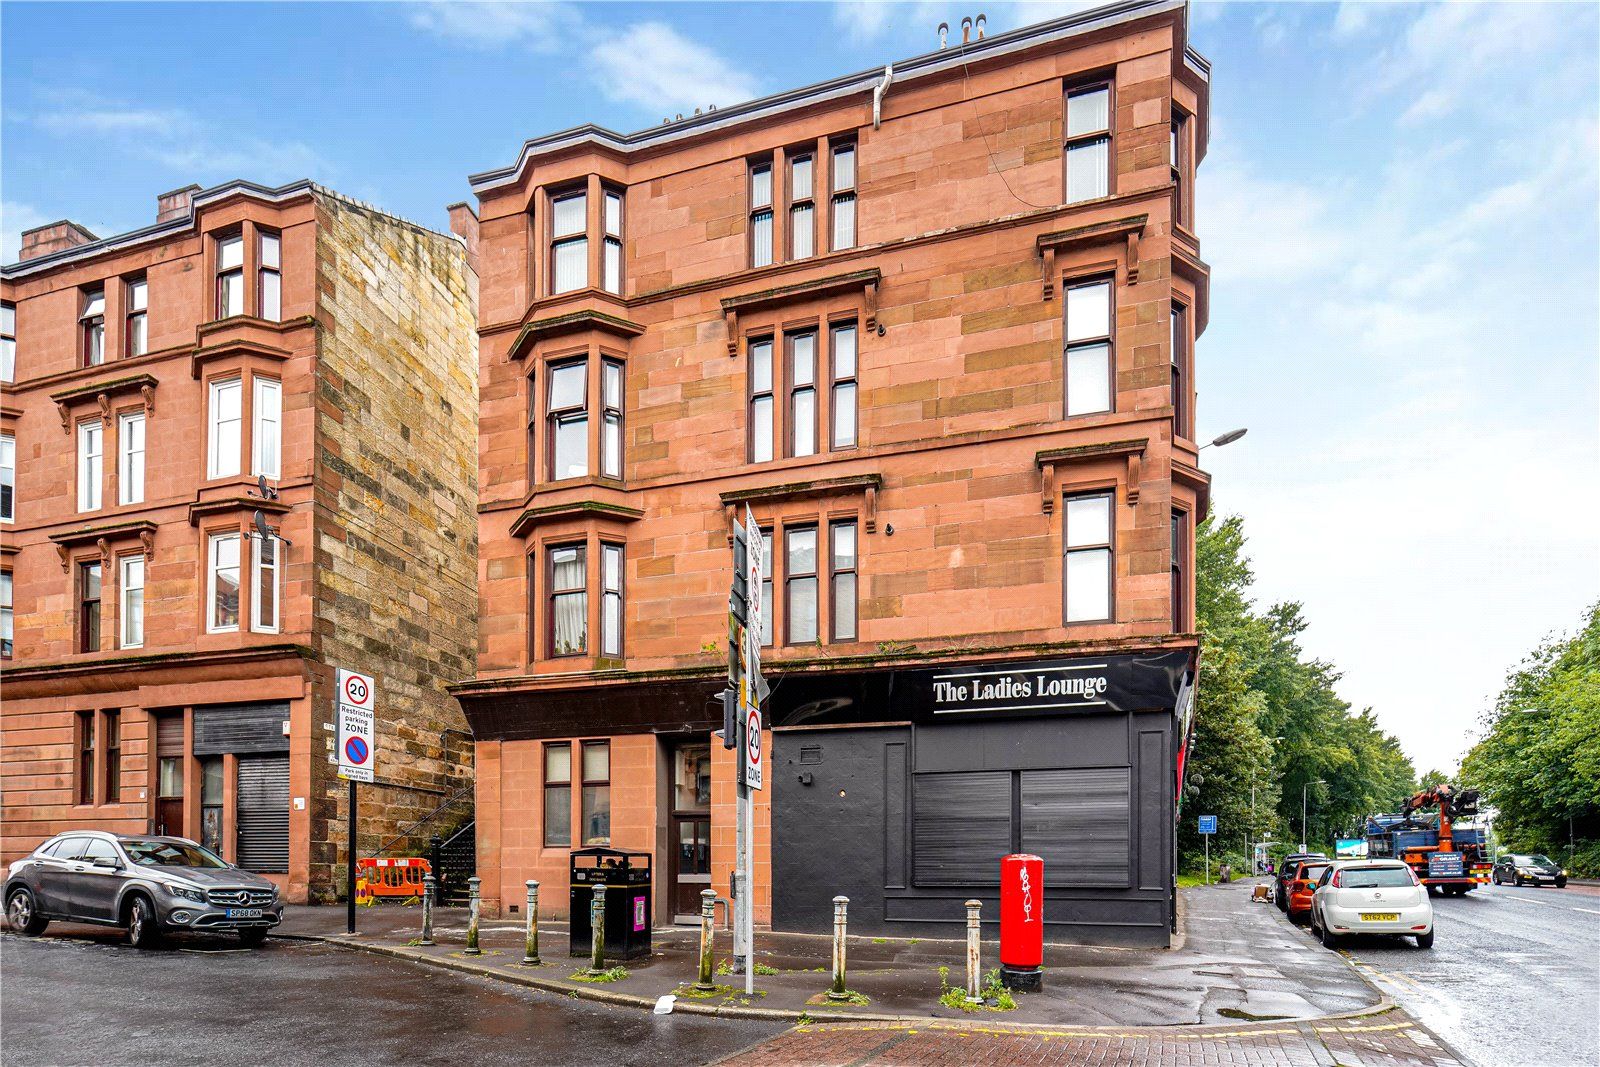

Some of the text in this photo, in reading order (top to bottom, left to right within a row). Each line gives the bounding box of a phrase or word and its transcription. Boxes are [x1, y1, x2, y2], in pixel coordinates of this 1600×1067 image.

[350, 683, 366, 697] 20
[933, 675, 1107, 703] The Ladies Lounge
[341, 705, 373, 719] Restricted
[345, 715, 368, 726] parking
[346, 723, 369, 735] ZONE
[750, 726, 759, 750] 20
[748, 766, 760, 783] ZONE
[231, 909, 249, 917] SP68
[1364, 913, 1380, 921] ST62
